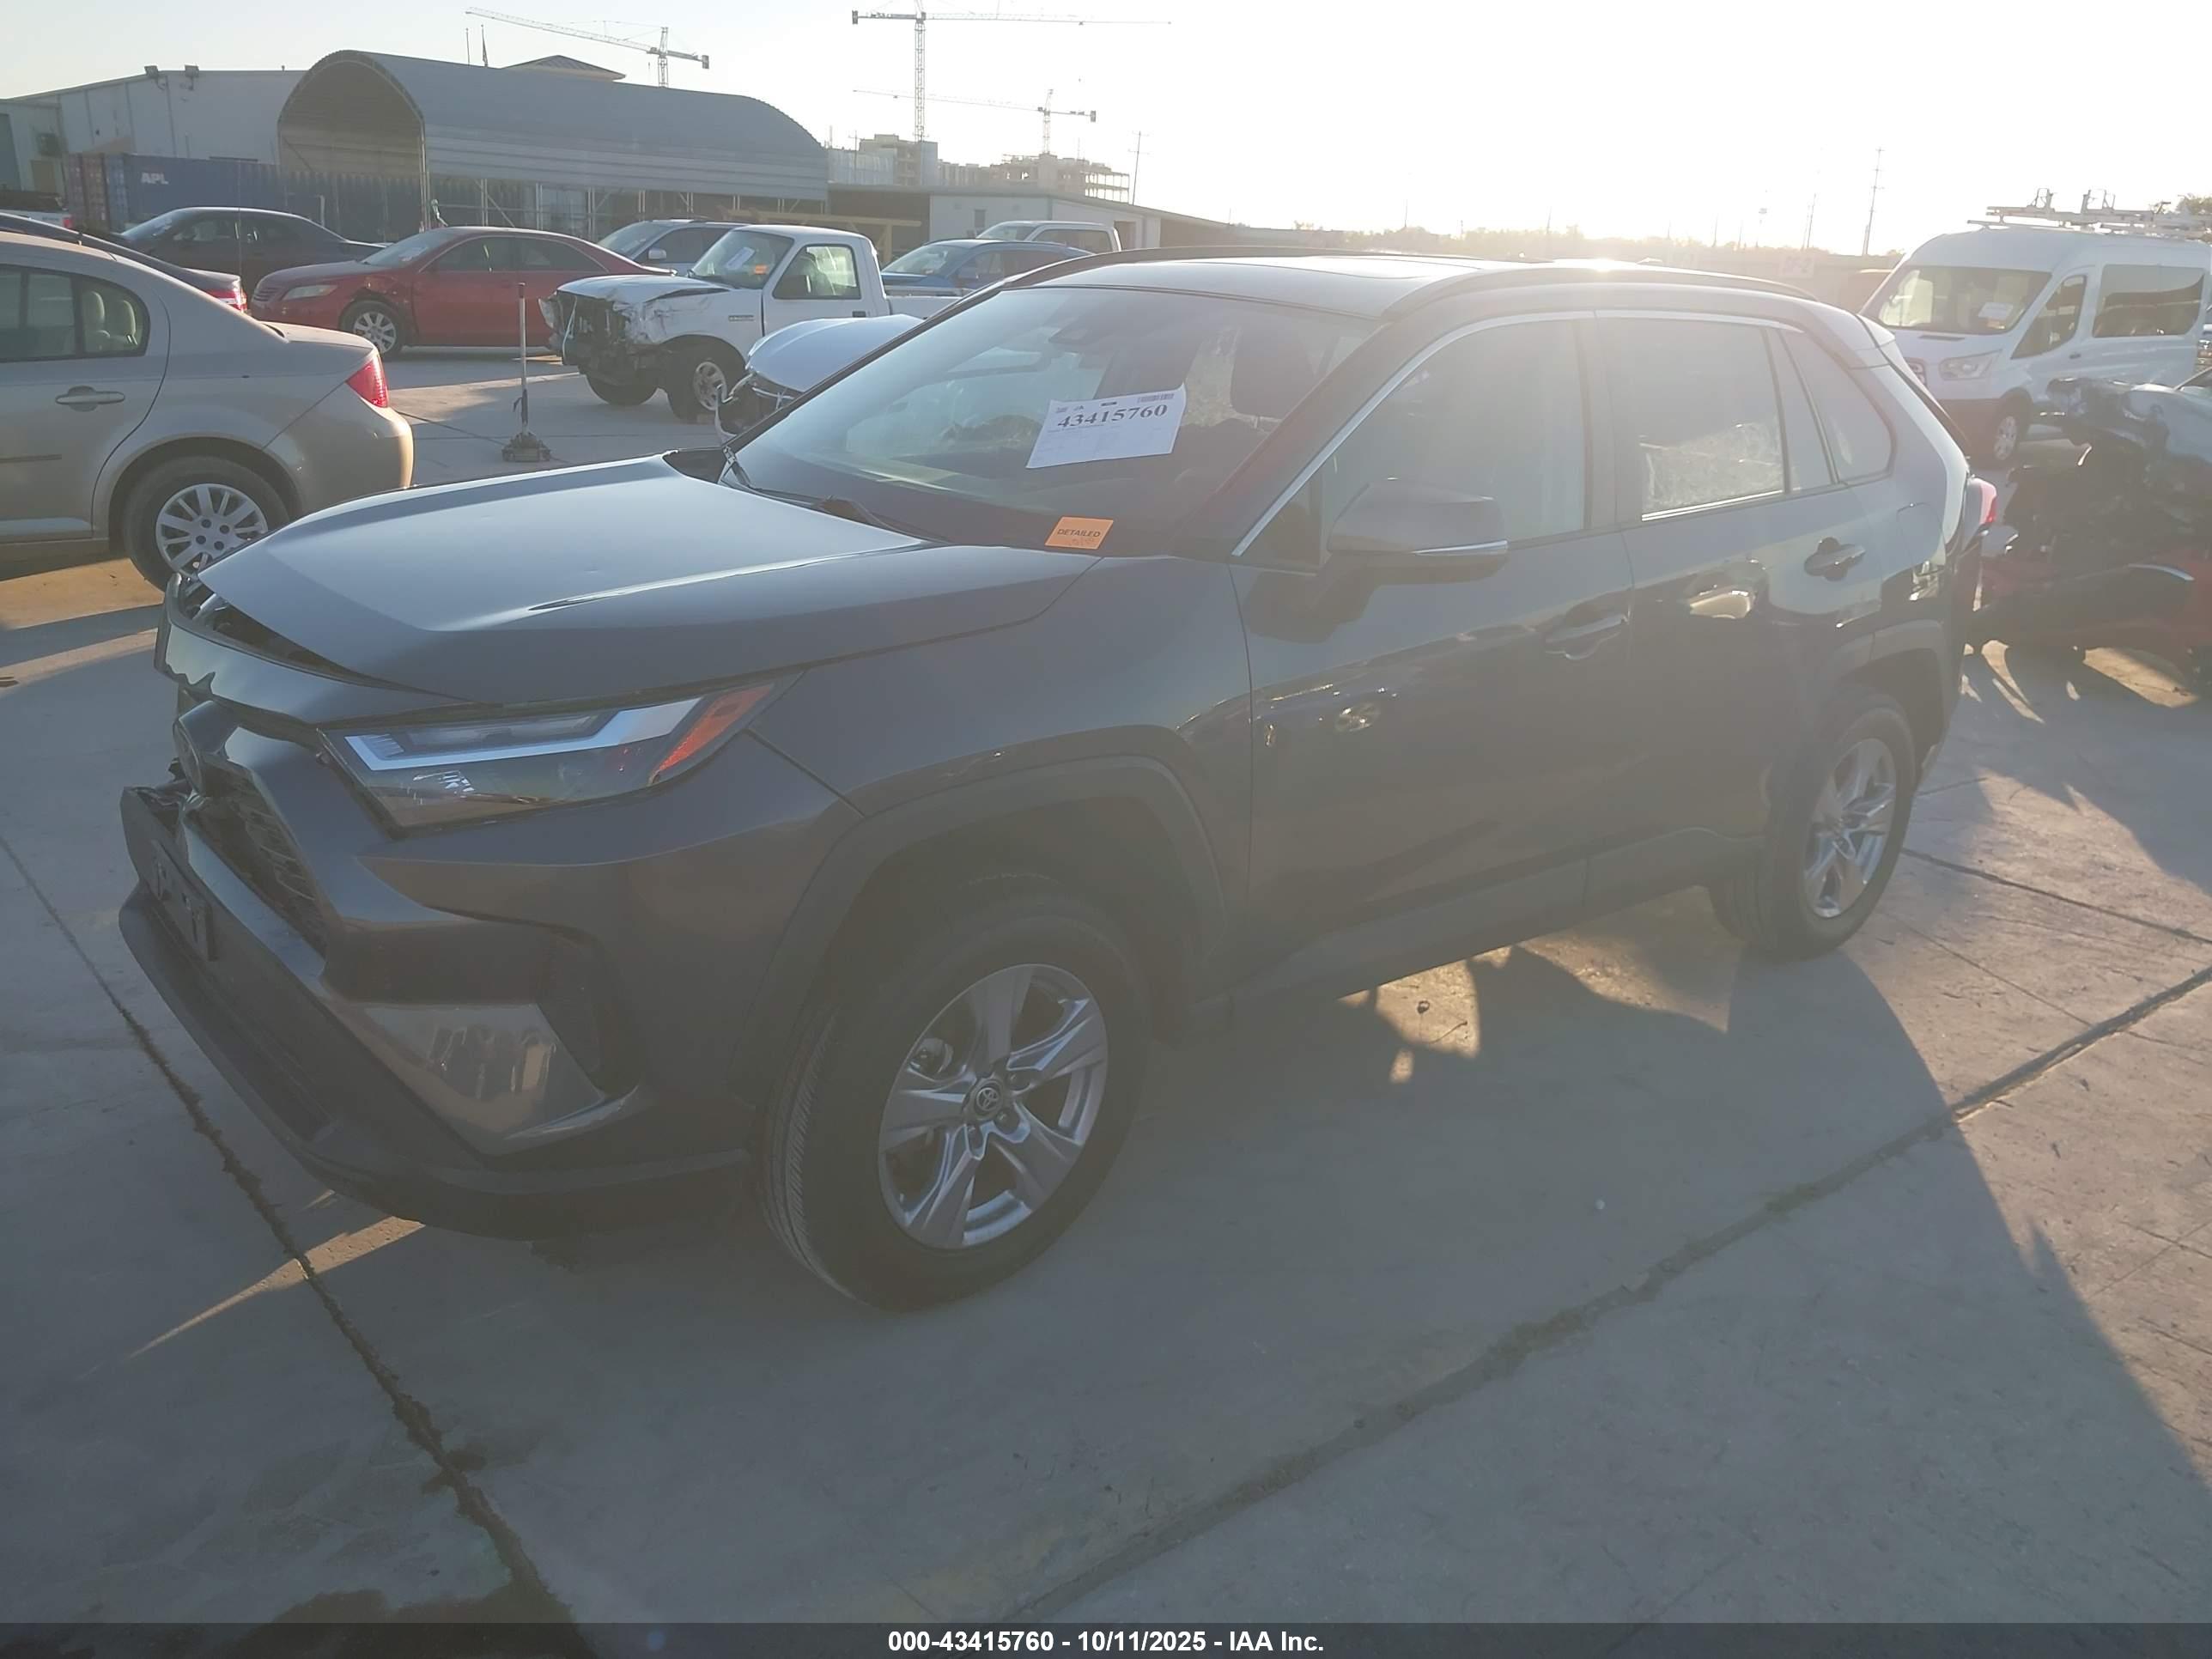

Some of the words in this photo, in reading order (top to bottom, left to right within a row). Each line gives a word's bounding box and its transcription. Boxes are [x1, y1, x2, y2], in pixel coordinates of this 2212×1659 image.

[141, 172, 169, 185] APL
[1057, 404, 1168, 428] 43415760
[1056, 529, 1101, 538] DETAILED
